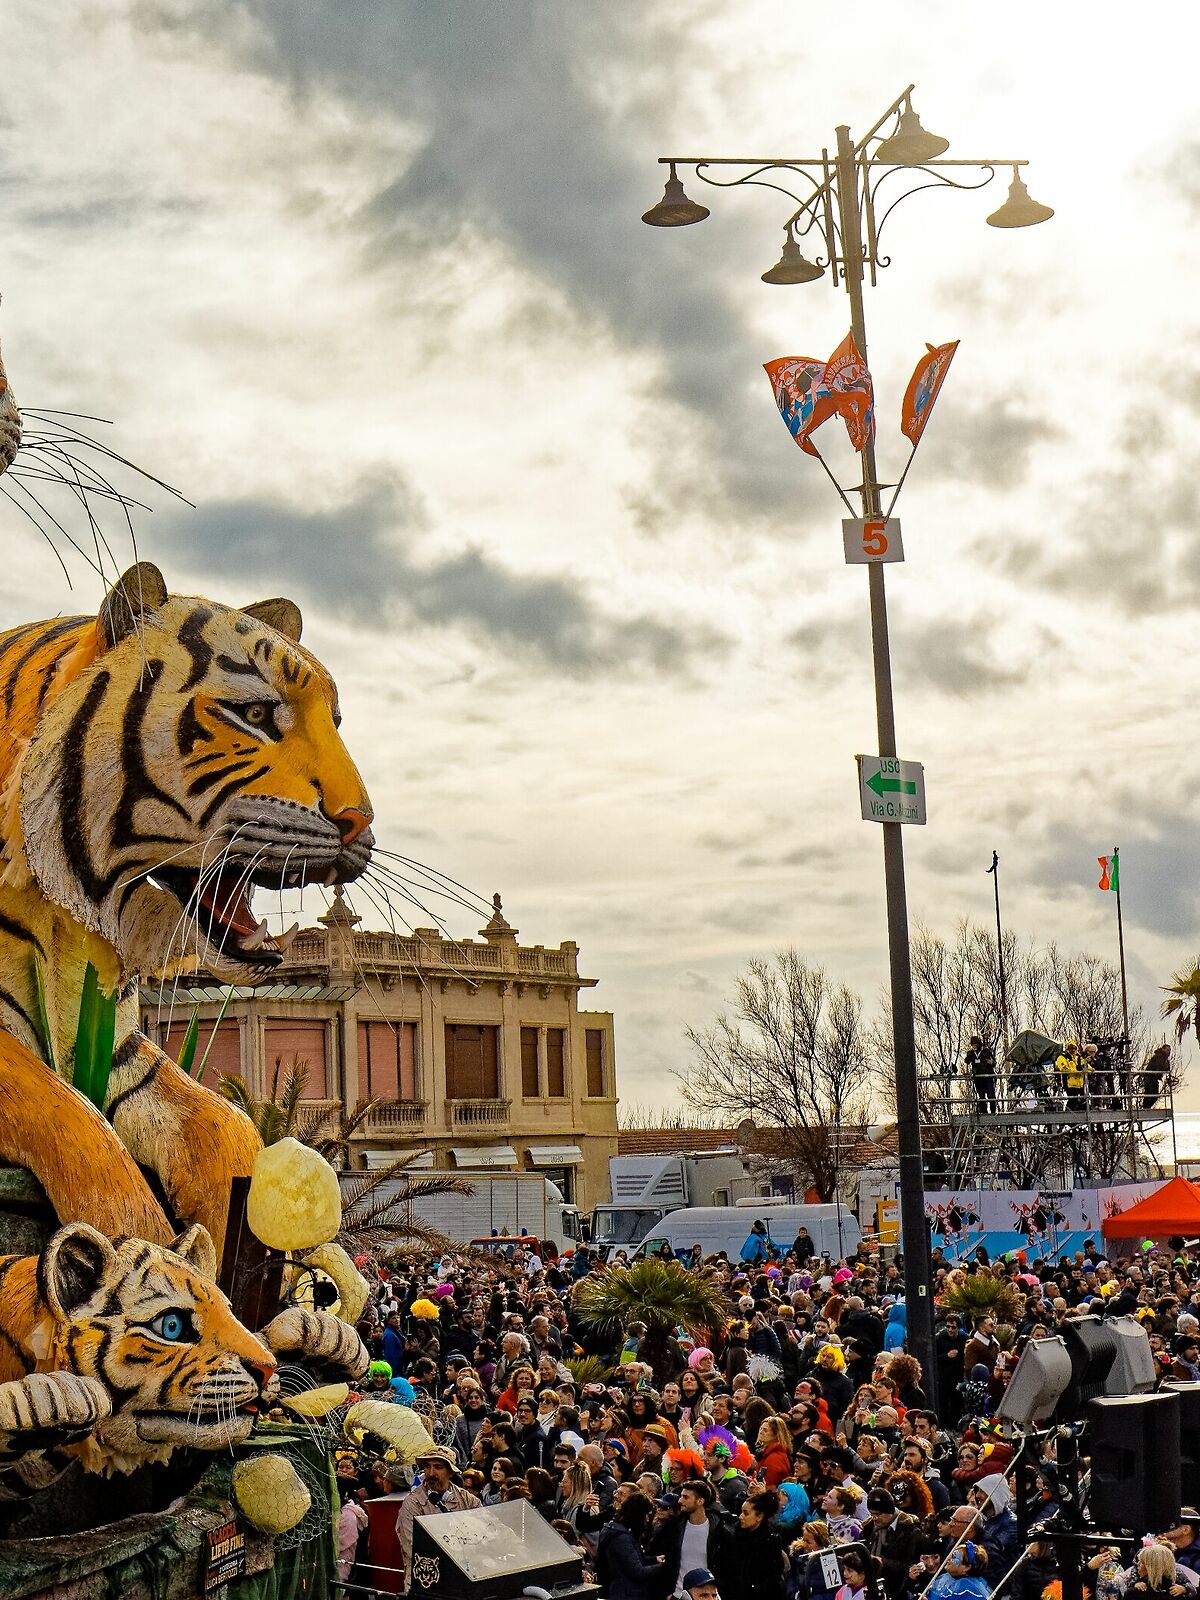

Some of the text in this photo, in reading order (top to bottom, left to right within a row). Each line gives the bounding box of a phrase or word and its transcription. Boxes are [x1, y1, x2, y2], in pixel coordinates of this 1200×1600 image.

[862, 522, 888, 556] 5
[870, 801, 884, 816] Via
[211, 1538, 230, 1561] LIETO
[230, 1533, 245, 1552] FINE
[827, 1569, 839, 1586] 12
